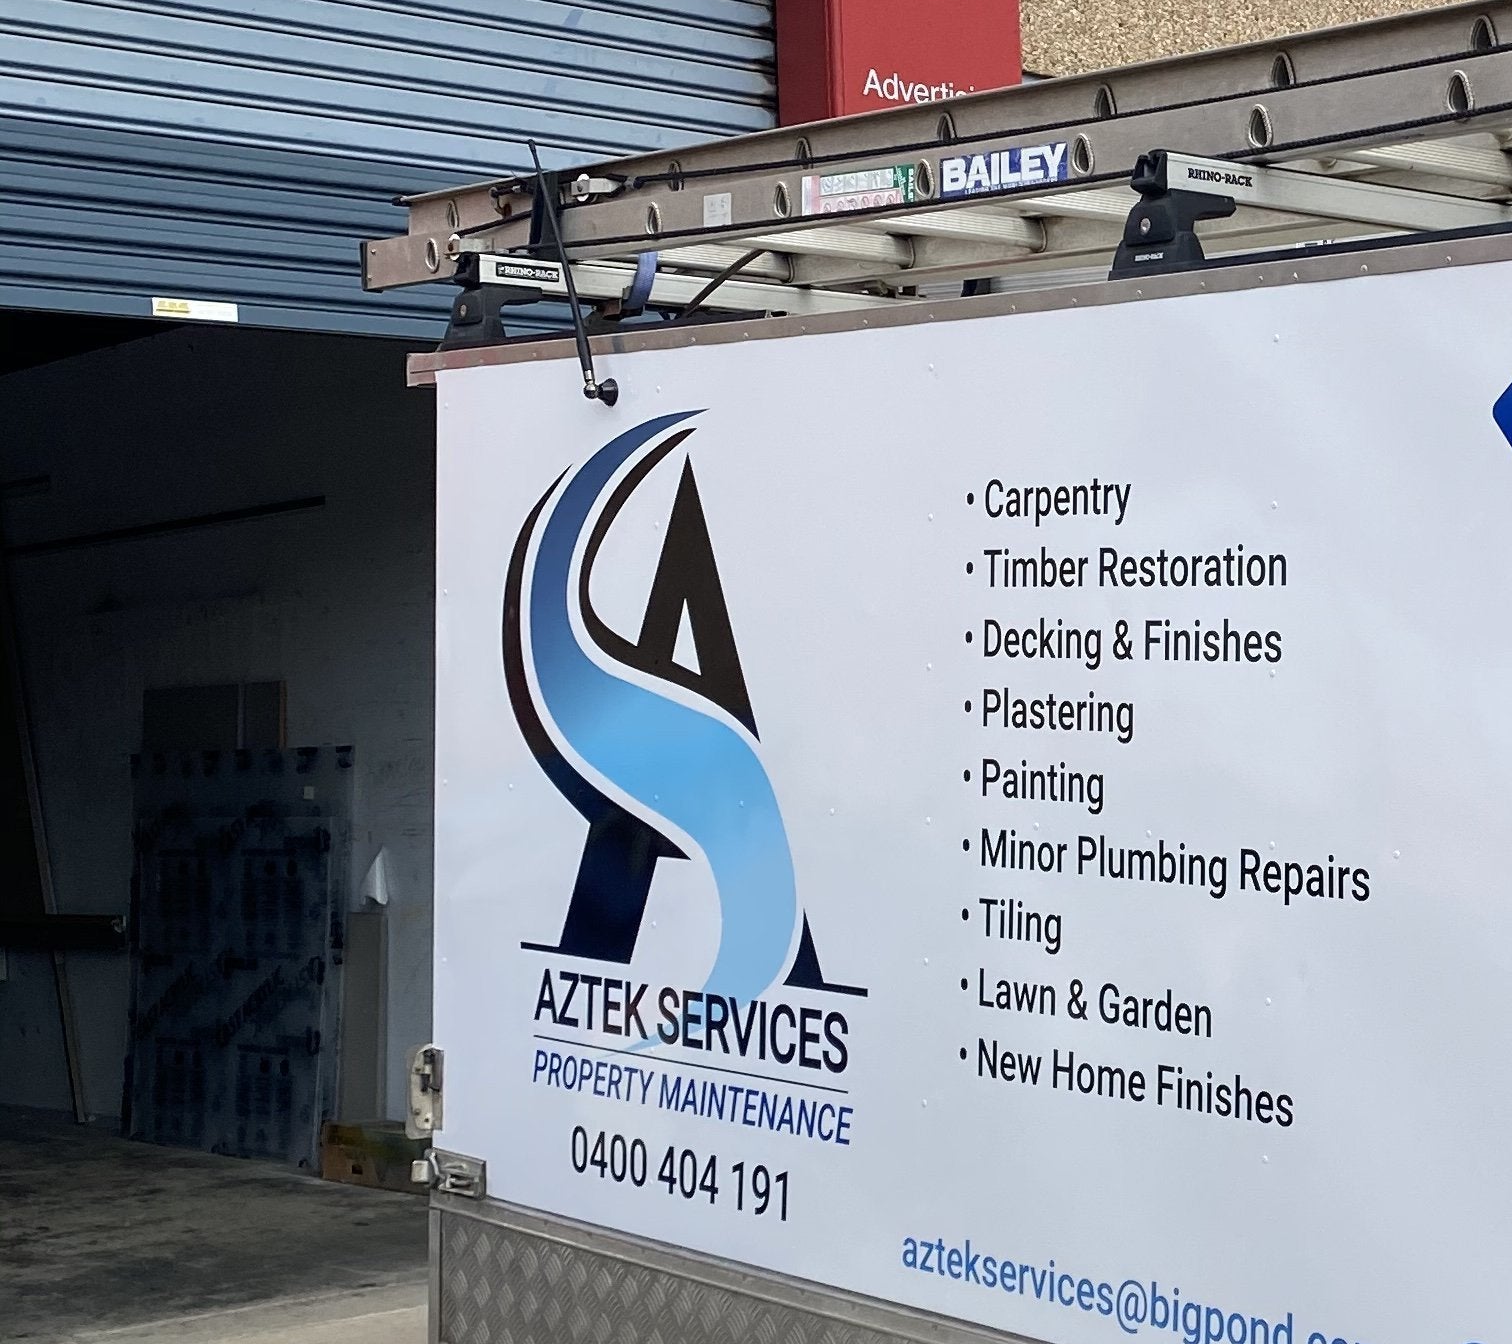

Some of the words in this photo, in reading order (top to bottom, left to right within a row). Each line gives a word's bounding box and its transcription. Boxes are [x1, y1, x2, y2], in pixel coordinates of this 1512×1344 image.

[942, 143, 1067, 192] BAILEY
[1187, 167, 1253, 188] RHINO-RACK
[984, 478, 1132, 527] Carpentry
[983, 547, 1089, 588] Timber
[1098, 544, 1288, 588] Restoration
[983, 617, 1102, 671] Decking
[1112, 619, 1134, 661] &
[1144, 618, 1283, 664] Finishes
[982, 687, 1135, 744] Plastering
[981, 758, 1105, 815] Painting
[980, 828, 1068, 873] Minor
[1077, 834, 1228, 899] Plumbing
[1239, 848, 1371, 906] Repairs
[978, 898, 1062, 955] Tiling
[534, 968, 649, 1041] AZTEK
[657, 986, 849, 1074] SERVICES
[978, 968, 1056, 1016] Lawn
[1067, 978, 1089, 1021] &
[1099, 983, 1212, 1038] Garden
[532, 1050, 655, 1105] PROPERTY
[658, 1074, 854, 1146] MAINTENANCE
[977, 1037, 1042, 1086] New
[1052, 1049, 1146, 1102] Home
[1157, 1064, 1294, 1128] Finishes
[571, 1125, 648, 1187] 0400
[657, 1146, 719, 1204] 404
[731, 1162, 790, 1222] 191
